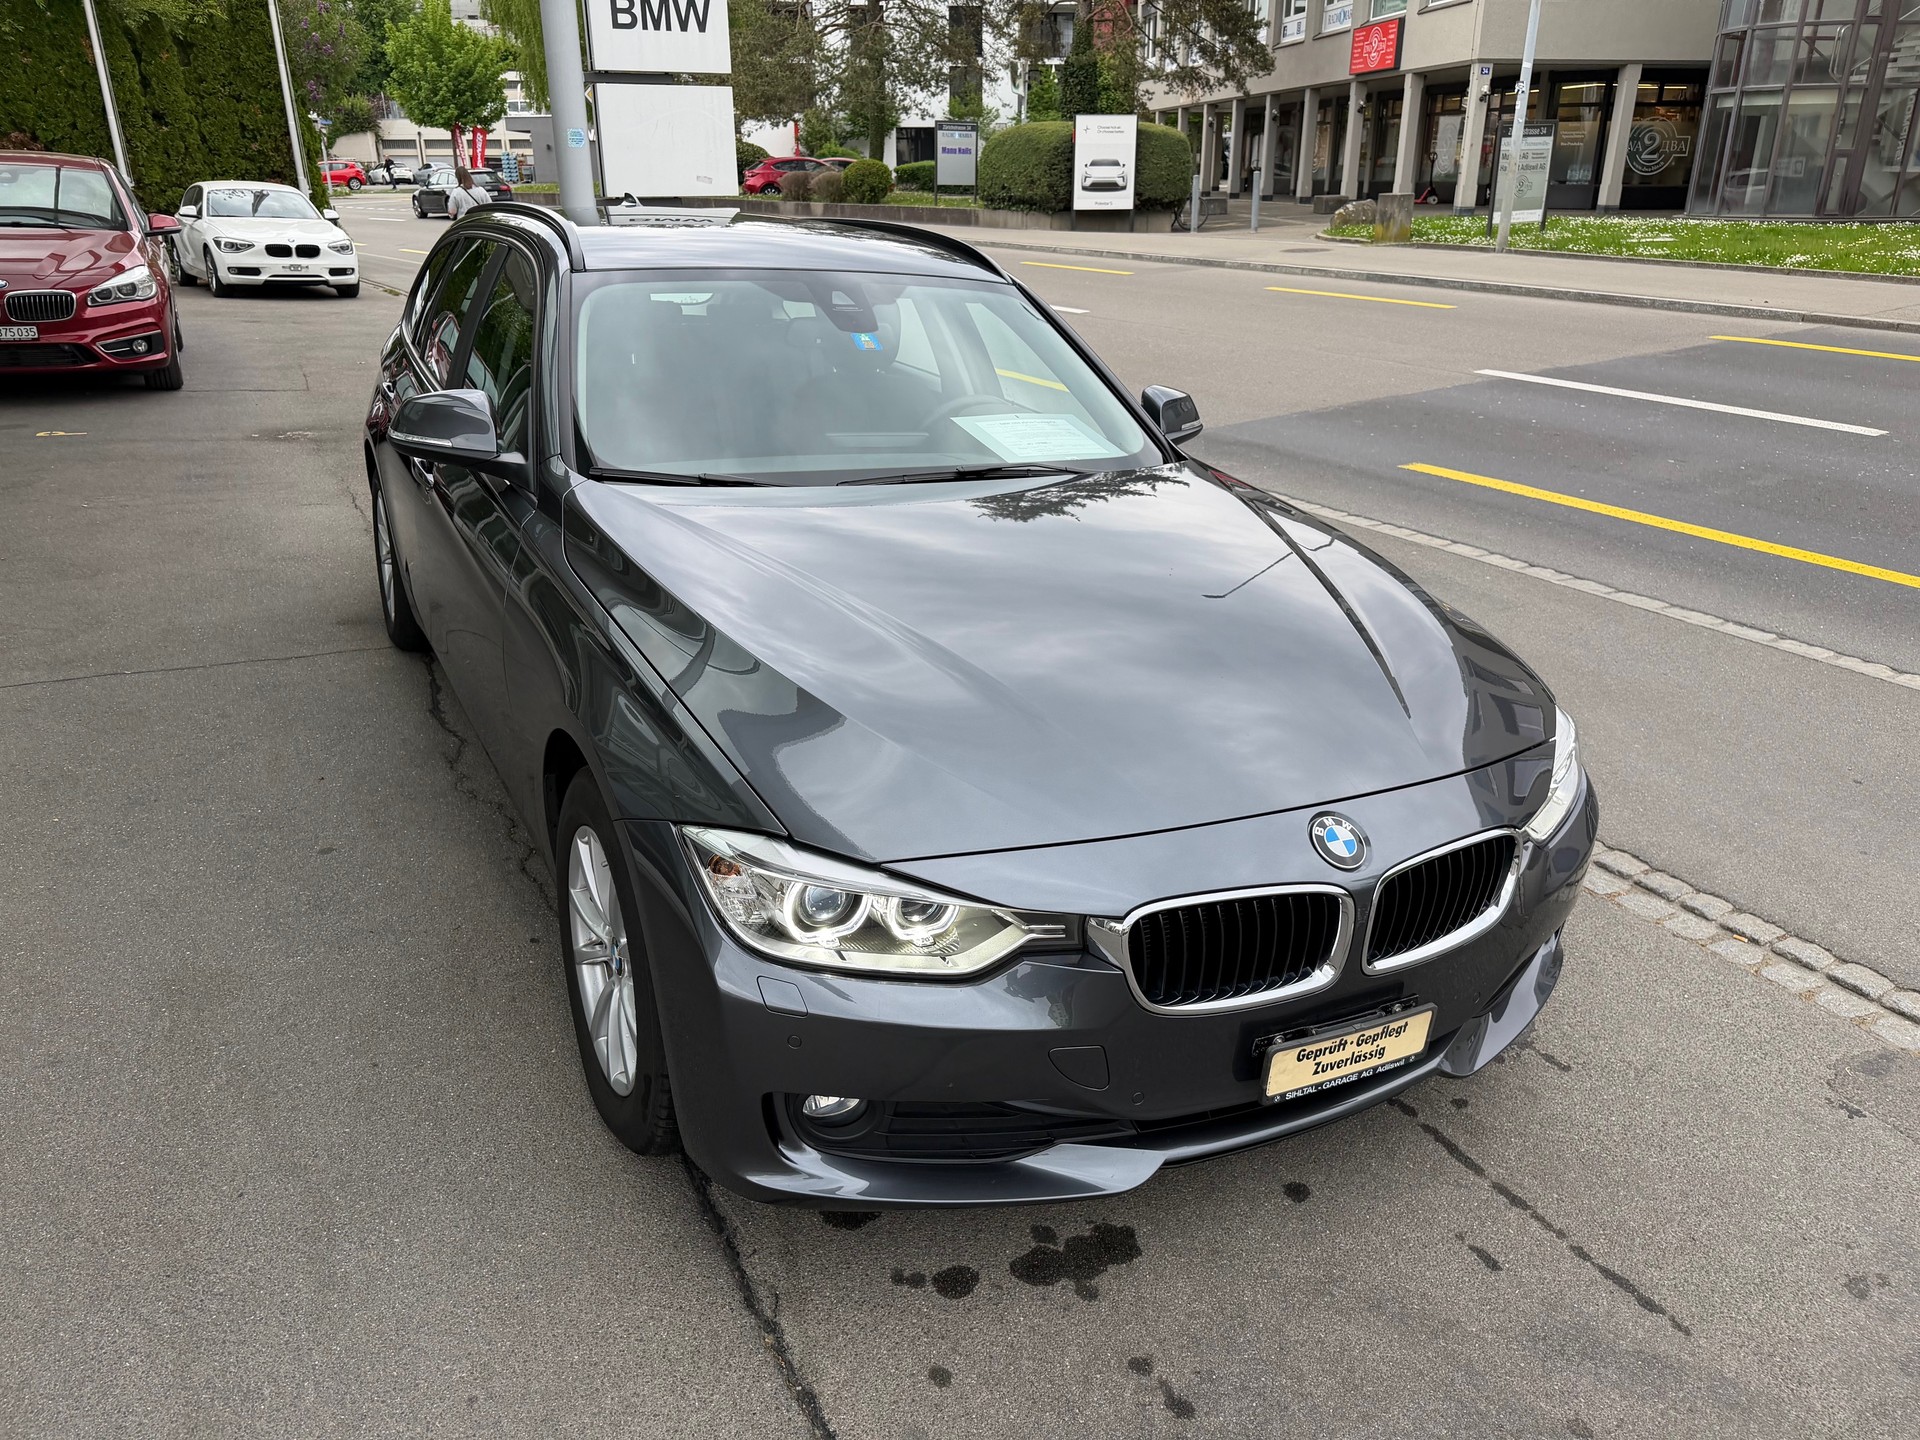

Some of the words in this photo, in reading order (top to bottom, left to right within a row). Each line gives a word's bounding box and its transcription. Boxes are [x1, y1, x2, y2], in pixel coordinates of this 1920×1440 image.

[610, 0, 710, 33] BMW
[1482, 67, 1489, 75] 34
[1540, 127, 1547, 135] 34
[1641, 132, 1661, 160] 2
[1659, 140, 1686, 153] ДВА
[1539, 162, 1546, 170] AG
[1315, 817, 1353, 837] BMW
[1296, 1038, 1348, 1063] Geprüft
[1356, 1021, 1409, 1047] Gepflegt
[1312, 1044, 1386, 1076] Zuverlässig
[1360, 1068, 1374, 1078] AG
[1376, 1058, 1405, 1074] Adliswil
